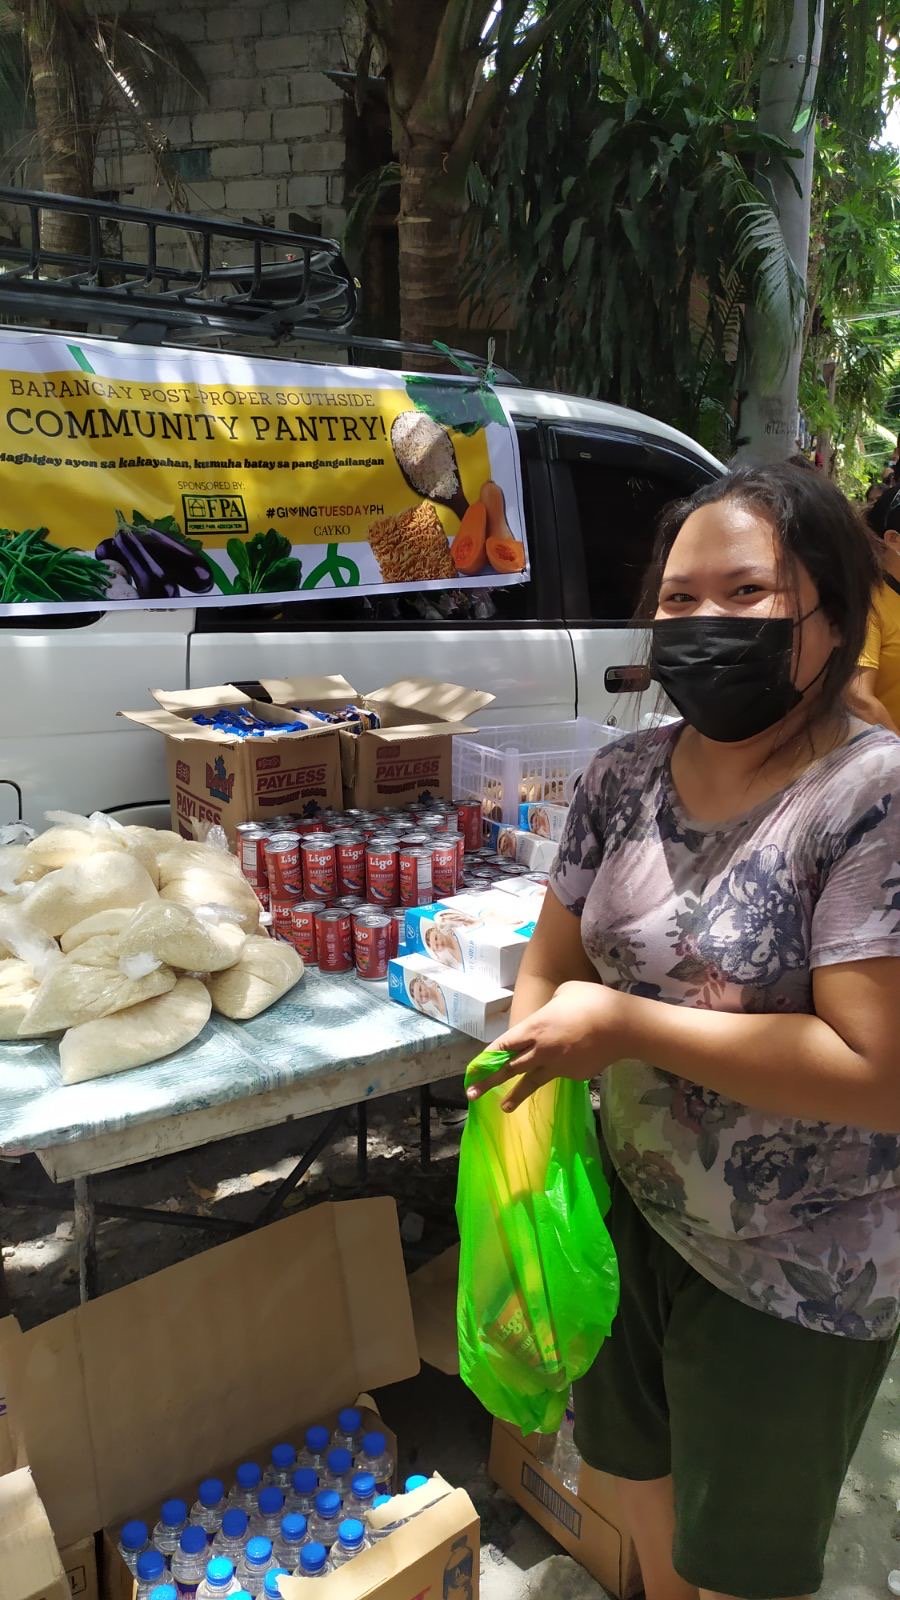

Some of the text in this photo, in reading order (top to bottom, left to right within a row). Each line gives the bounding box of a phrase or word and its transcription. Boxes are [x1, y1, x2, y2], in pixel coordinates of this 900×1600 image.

[9, 379, 376, 407] BARANGAY POST-PROPER SOUTHSIDE
[6, 408, 389, 442] COMMUNITY PANTRY!
[65, 458, 98, 468] ayon
[100, 461, 116, 469] sa
[118, 456, 192, 470] kakayahan,
[194, 457, 242, 470] kumuha
[243, 458, 276, 470] batay
[277, 460, 292, 469] sa
[291, 457, 385, 470] pangangailangan
[177, 481, 246, 491] SPONSORED BY:
[206, 498, 243, 518] FPA
[313, 525, 351, 537] CAYKO
[376, 760, 440, 779] PAYLESS
[256, 767, 327, 791] PAYLESS
[281, 854, 298, 865] Lig
[308, 854, 332, 866] Ligo
[370, 857, 393, 870] Ligo
[433, 854, 453, 866] igo
[273, 905, 292, 917] Lig
